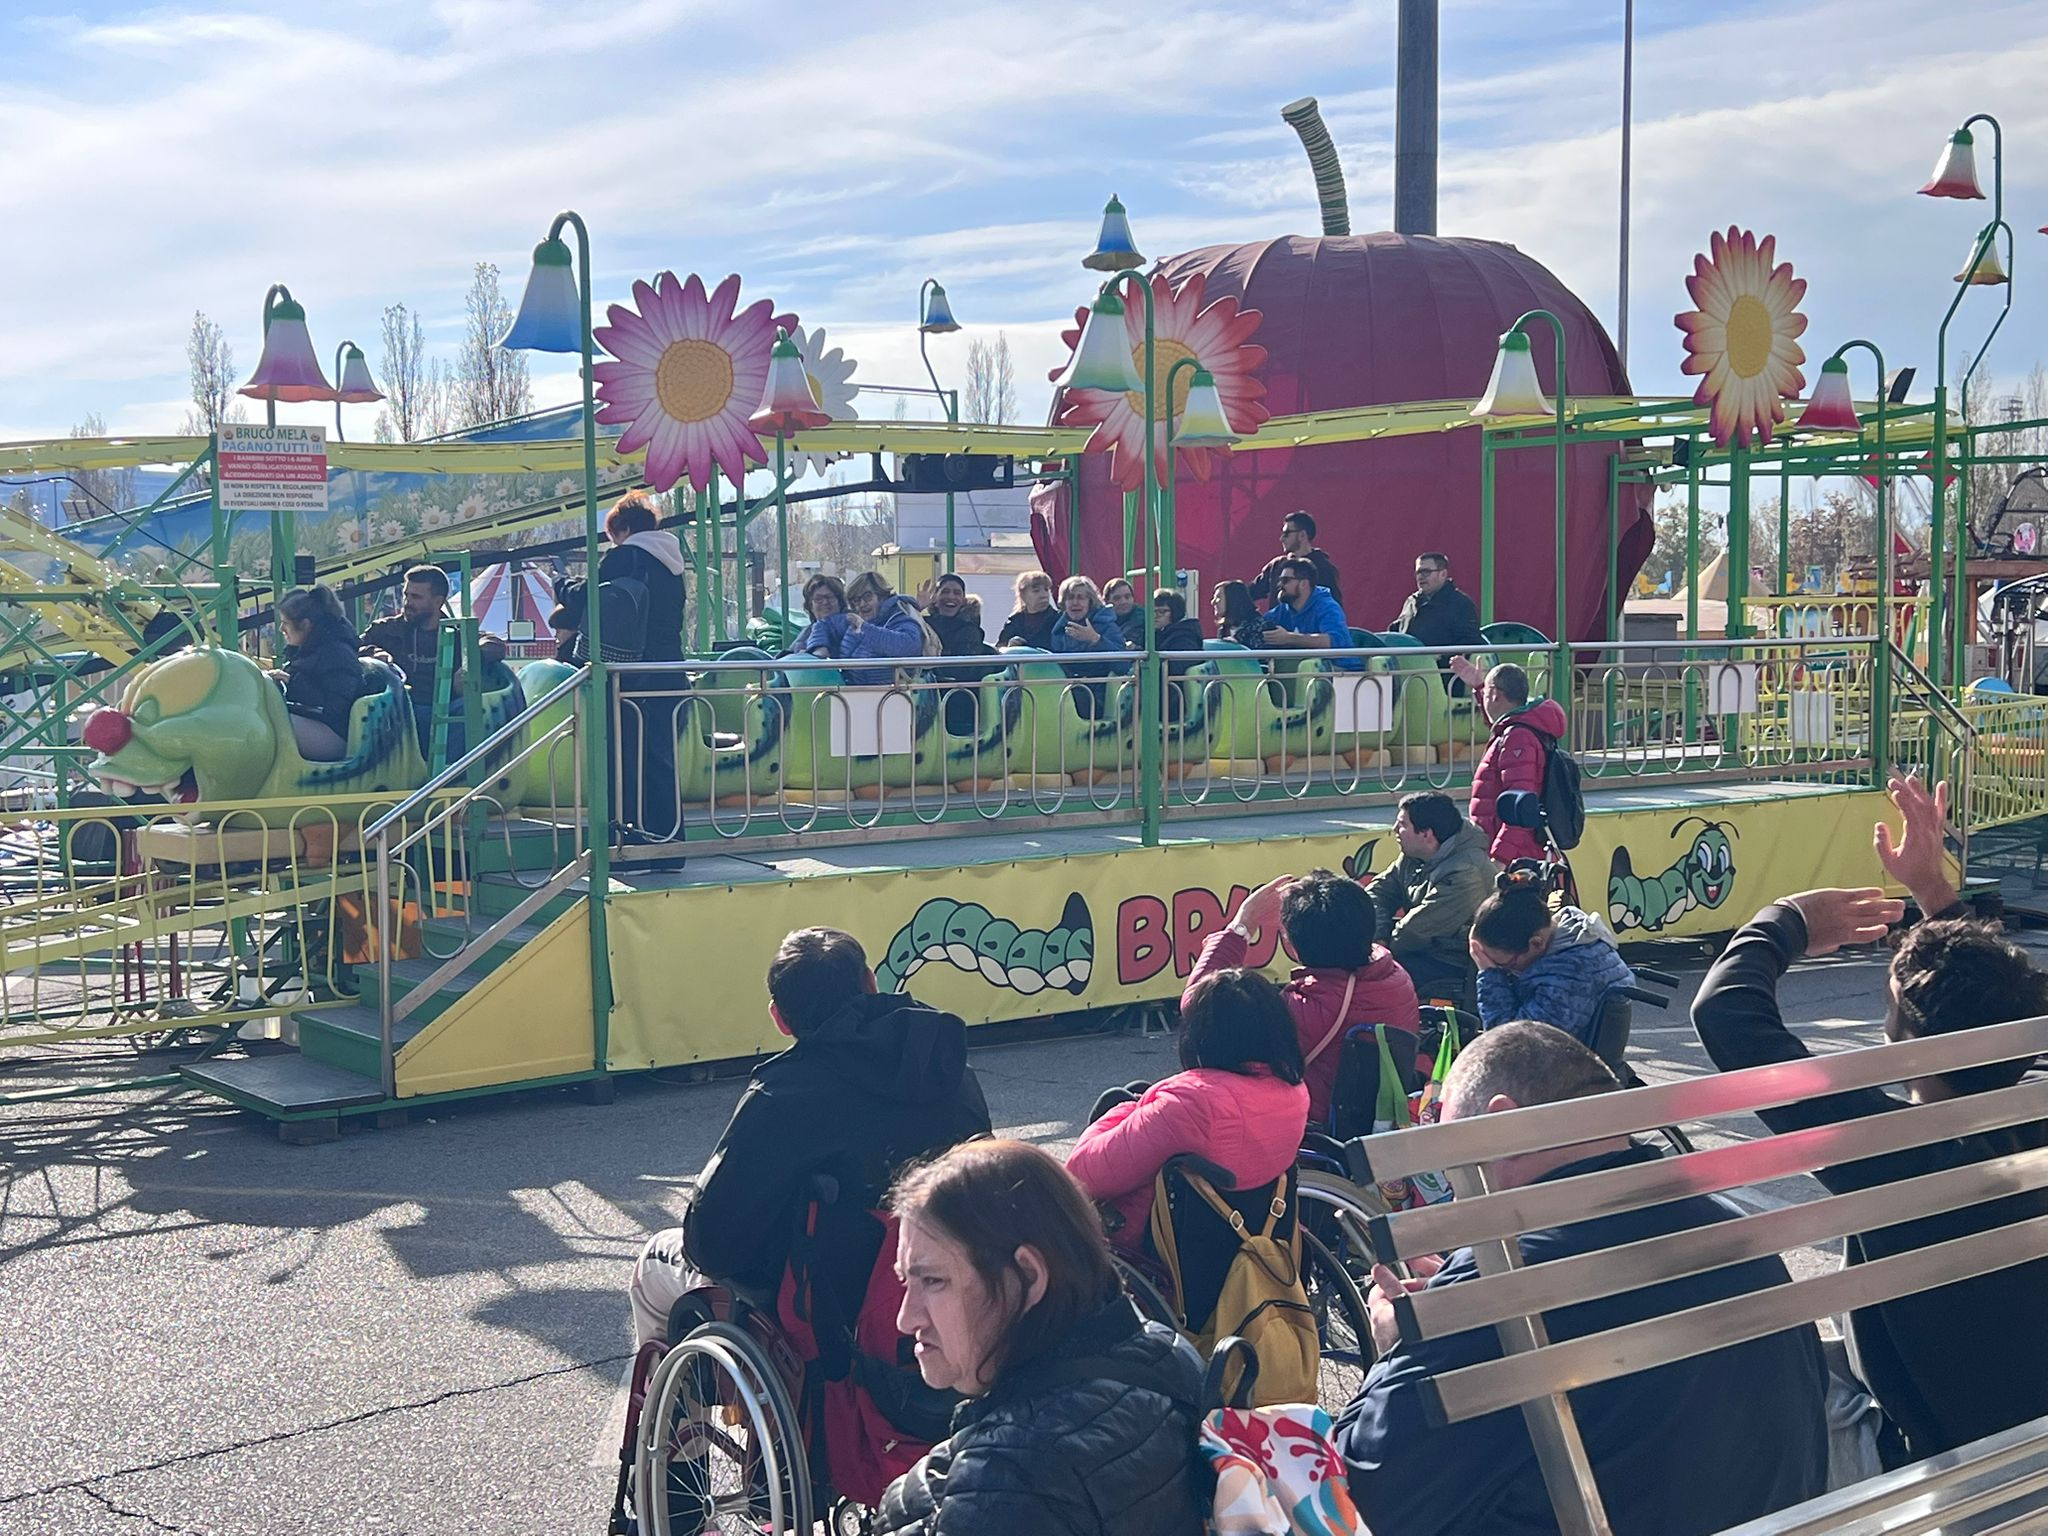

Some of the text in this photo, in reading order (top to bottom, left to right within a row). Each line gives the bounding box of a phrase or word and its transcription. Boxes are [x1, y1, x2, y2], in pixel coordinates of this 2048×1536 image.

[236, 428, 308, 440] BRUCO MELA
[222, 441, 272, 452] PAGANO
[275, 442, 310, 452] TUTTI
